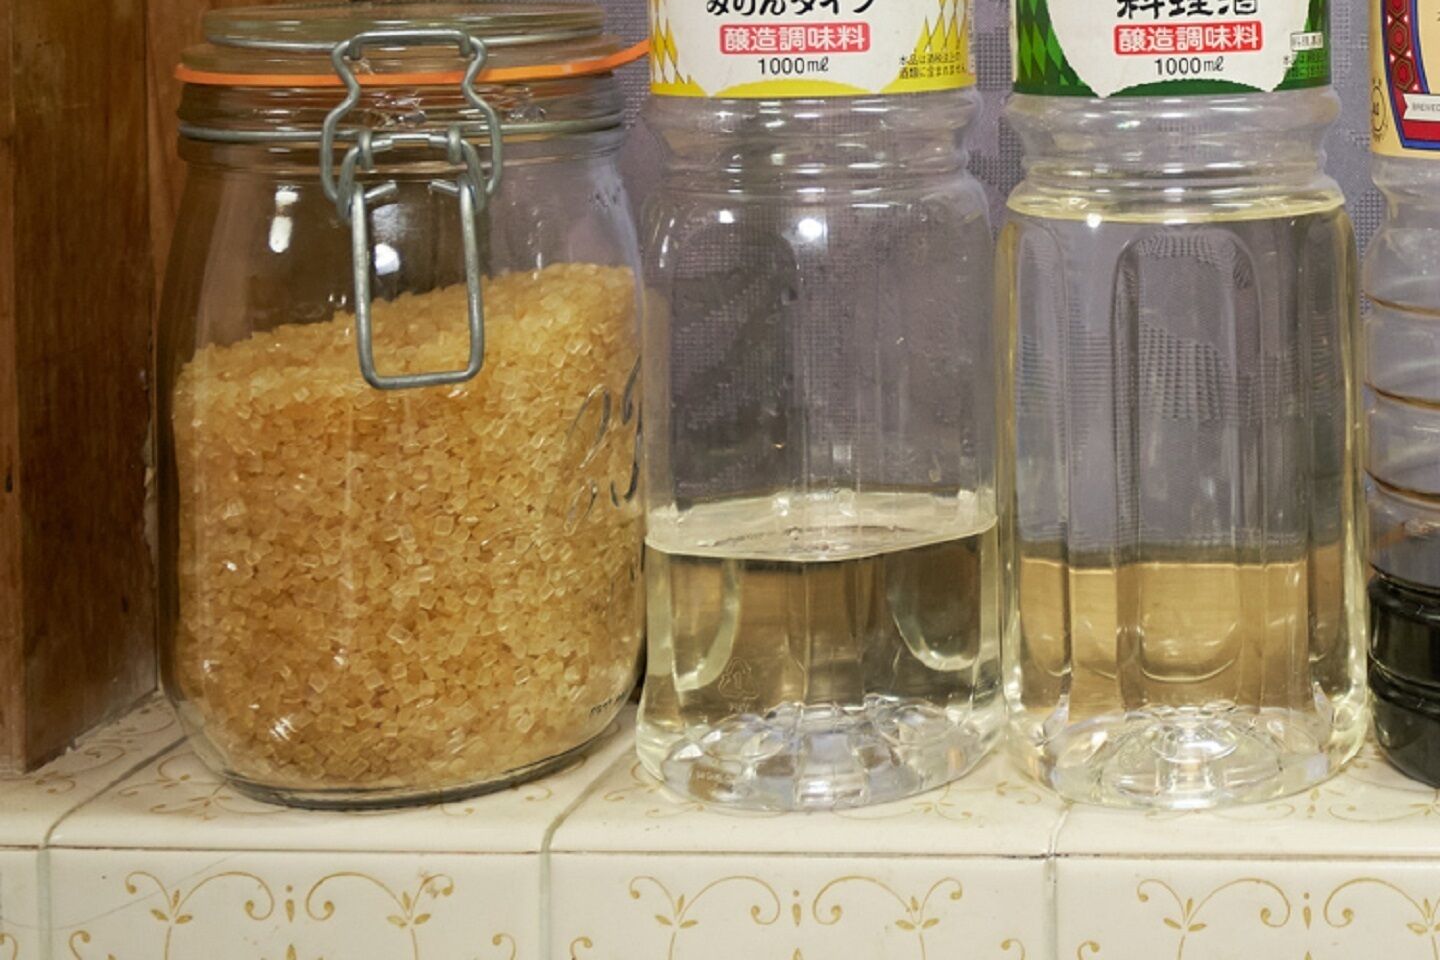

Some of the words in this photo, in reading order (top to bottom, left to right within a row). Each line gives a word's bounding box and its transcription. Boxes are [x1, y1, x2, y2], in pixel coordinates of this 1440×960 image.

[724, 25, 866, 52] 醸造調味料
[1118, 24, 1259, 52] 醸造調味料
